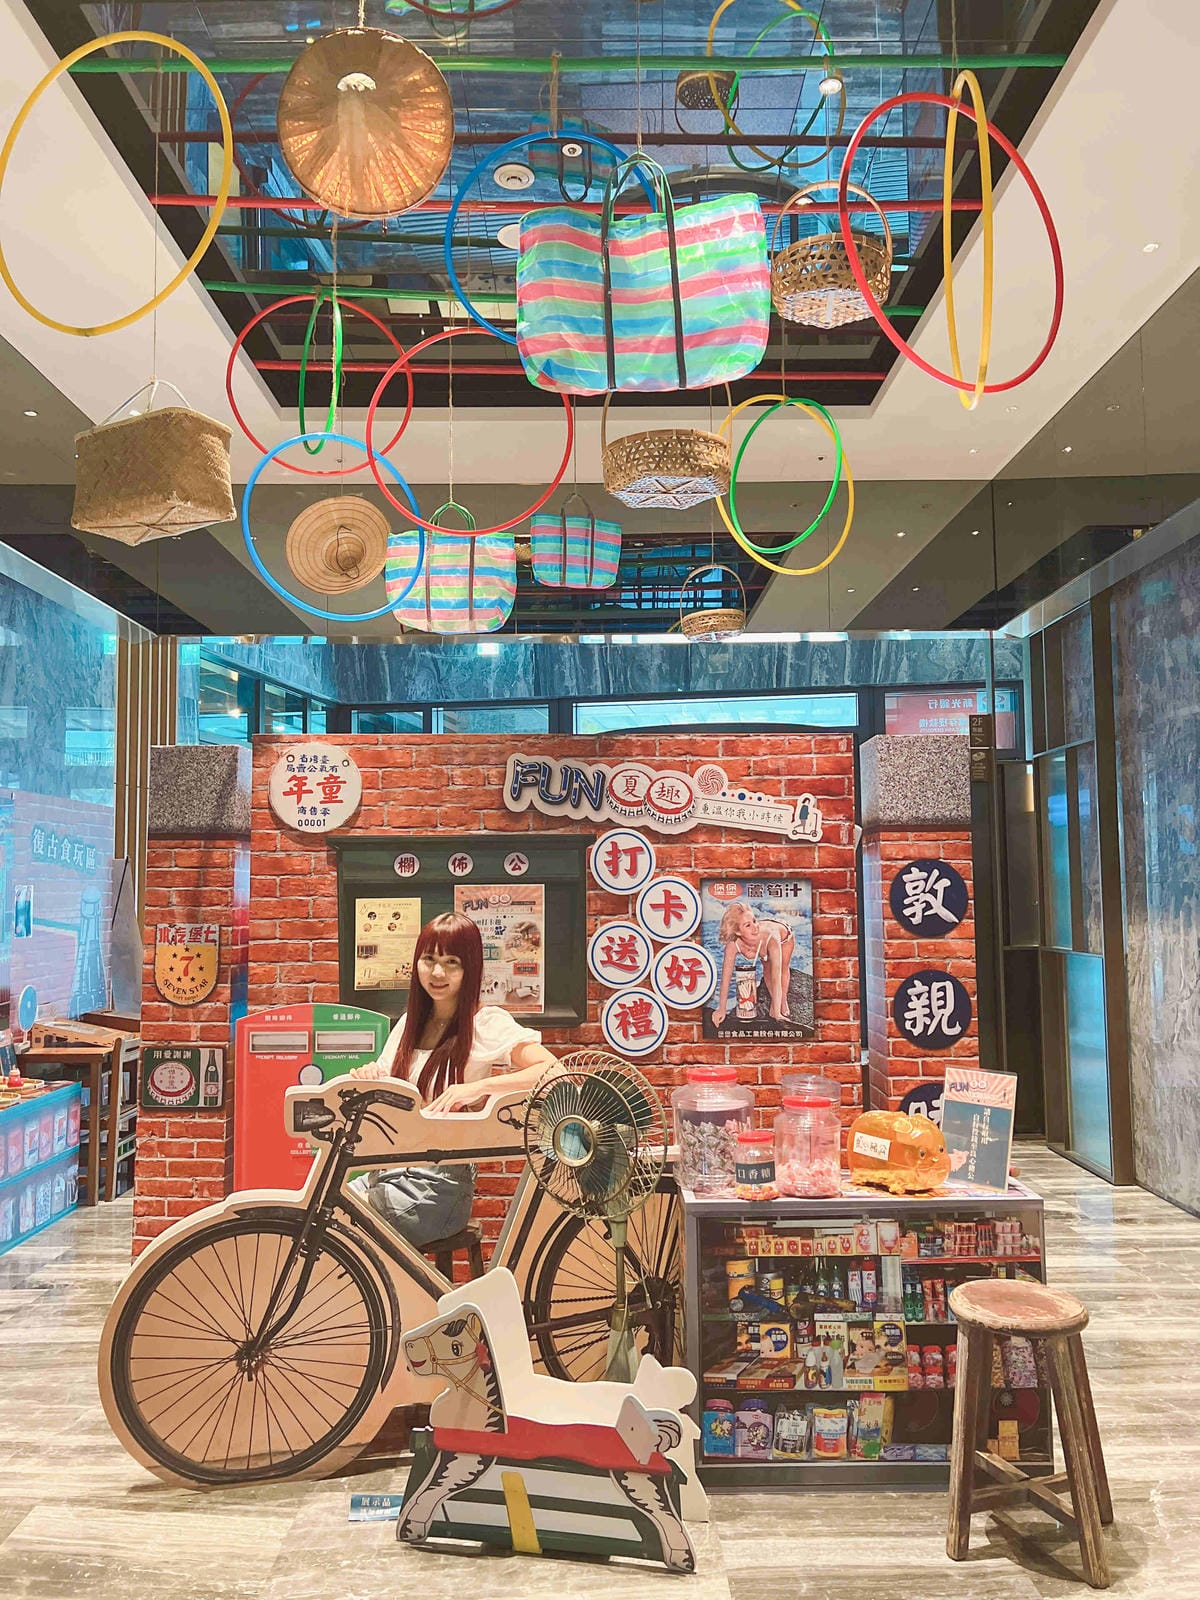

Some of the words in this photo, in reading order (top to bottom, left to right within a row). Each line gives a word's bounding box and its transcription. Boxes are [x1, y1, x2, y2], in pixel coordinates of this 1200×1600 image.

[282, 773, 347, 806] 童年
[510, 759, 605, 811] FUN
[297, 818, 326, 827] 00001
[700, 803, 783, 823] 重溫你我小時候
[33, 828, 96, 870] 復古食玩區
[747, 883, 802, 898] 蘆筍汁
[180, 956, 194, 977] 7
[163, 979, 187, 995] SEVEN
[189, 979, 208, 994] STAR
[738, 1168, 771, 1179] 口香糖
